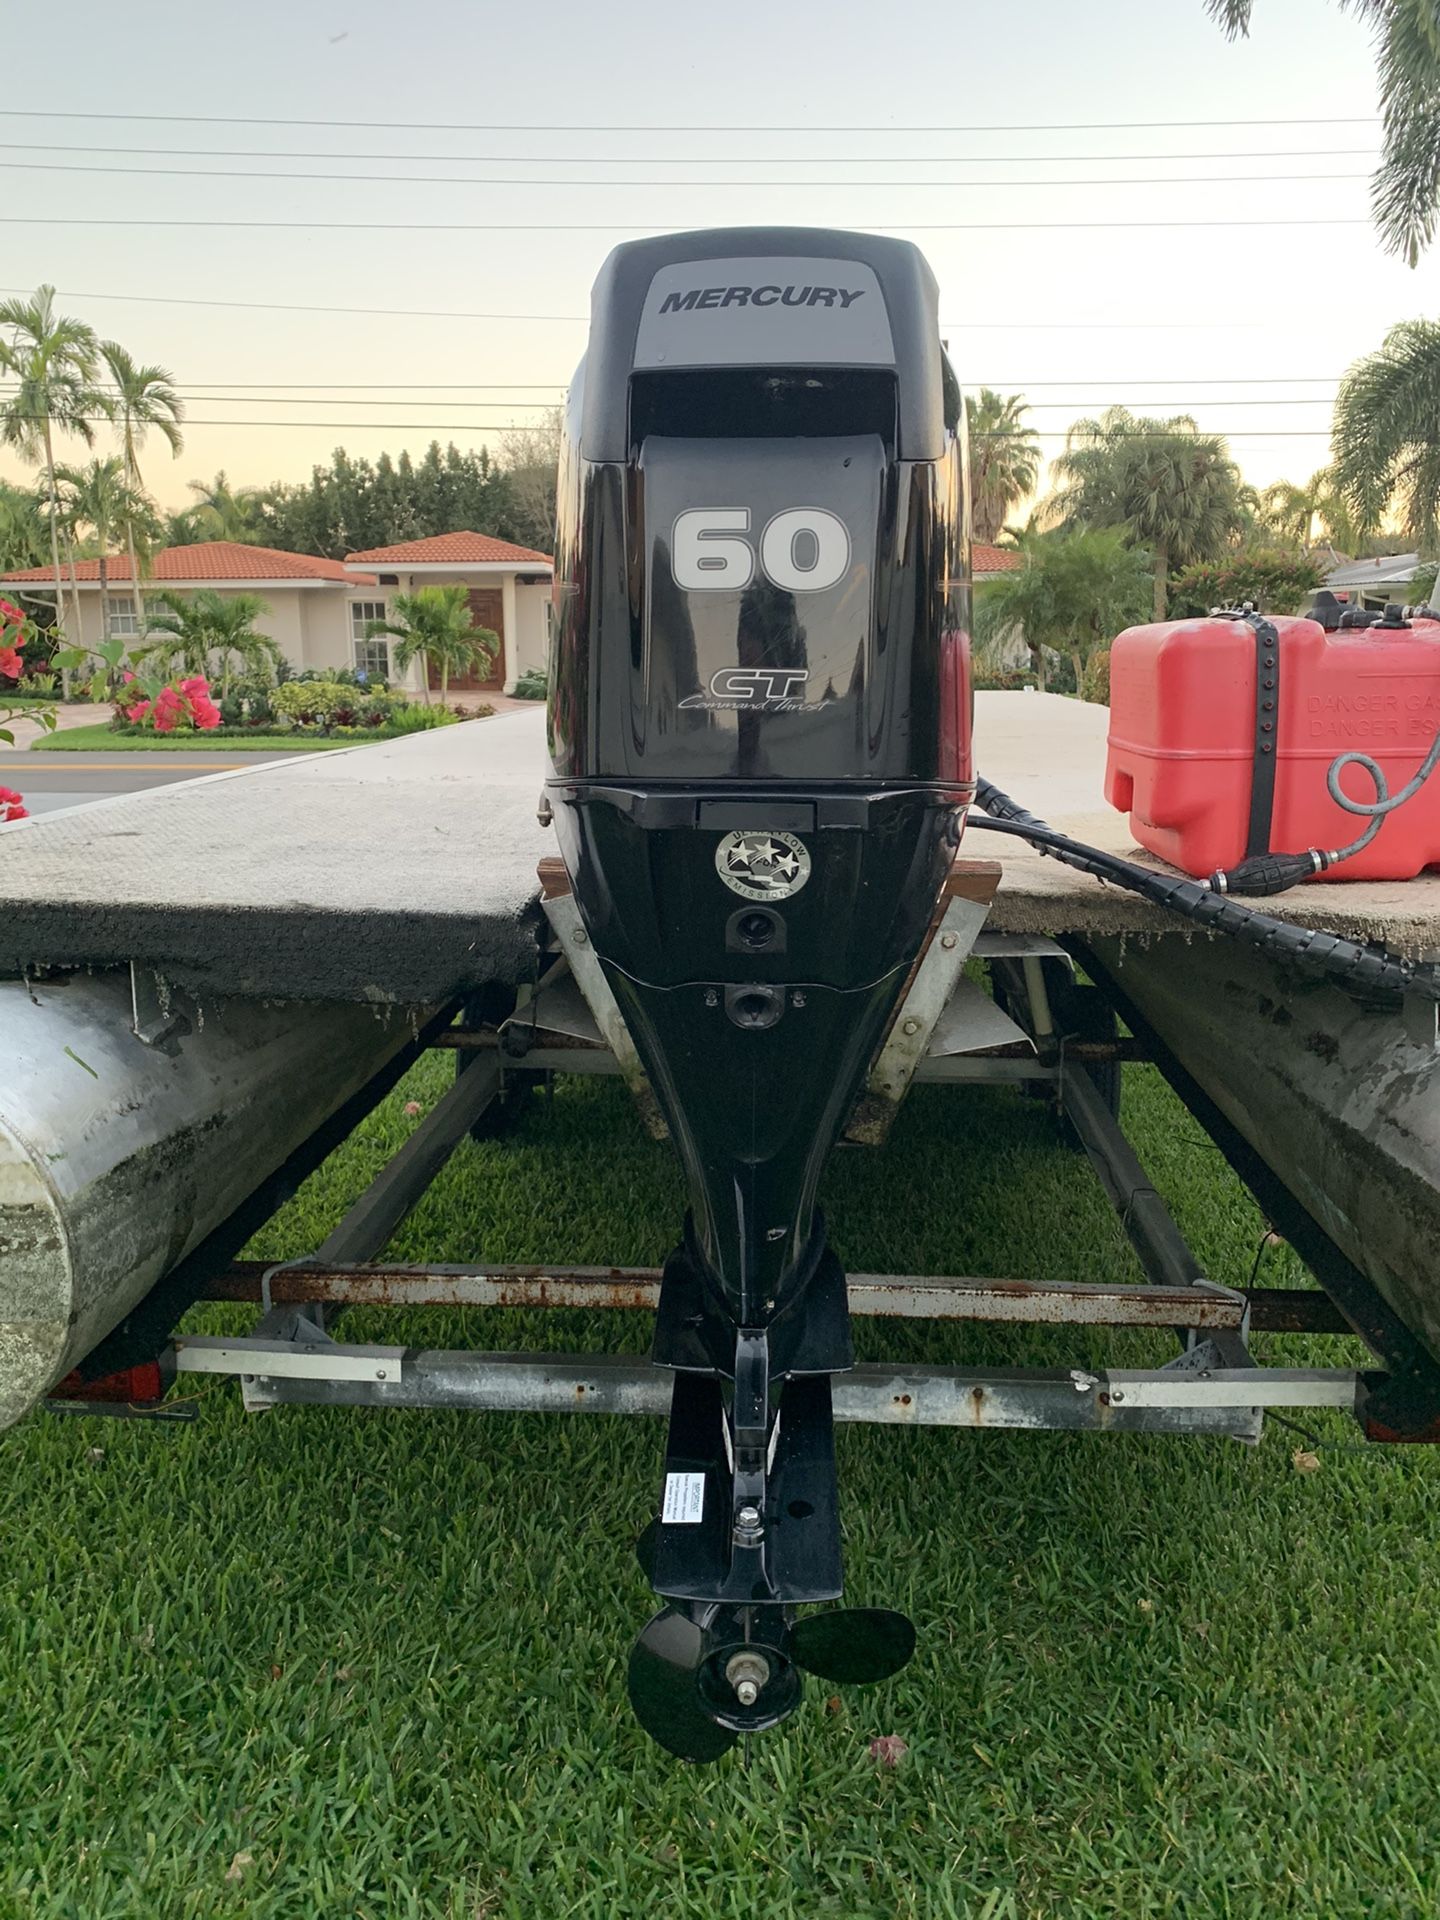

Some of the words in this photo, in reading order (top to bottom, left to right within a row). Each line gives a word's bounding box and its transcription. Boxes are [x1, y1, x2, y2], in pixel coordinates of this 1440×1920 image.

[658, 285, 865, 315] MERCURY
[670, 506, 852, 594] 60
[678, 694, 769, 711] Command
[771, 696, 835, 712] Thrust
[1307, 695, 1398, 713] DANGER
[1310, 718, 1400, 737] DANGER
[784, 834, 807, 856] LOW
